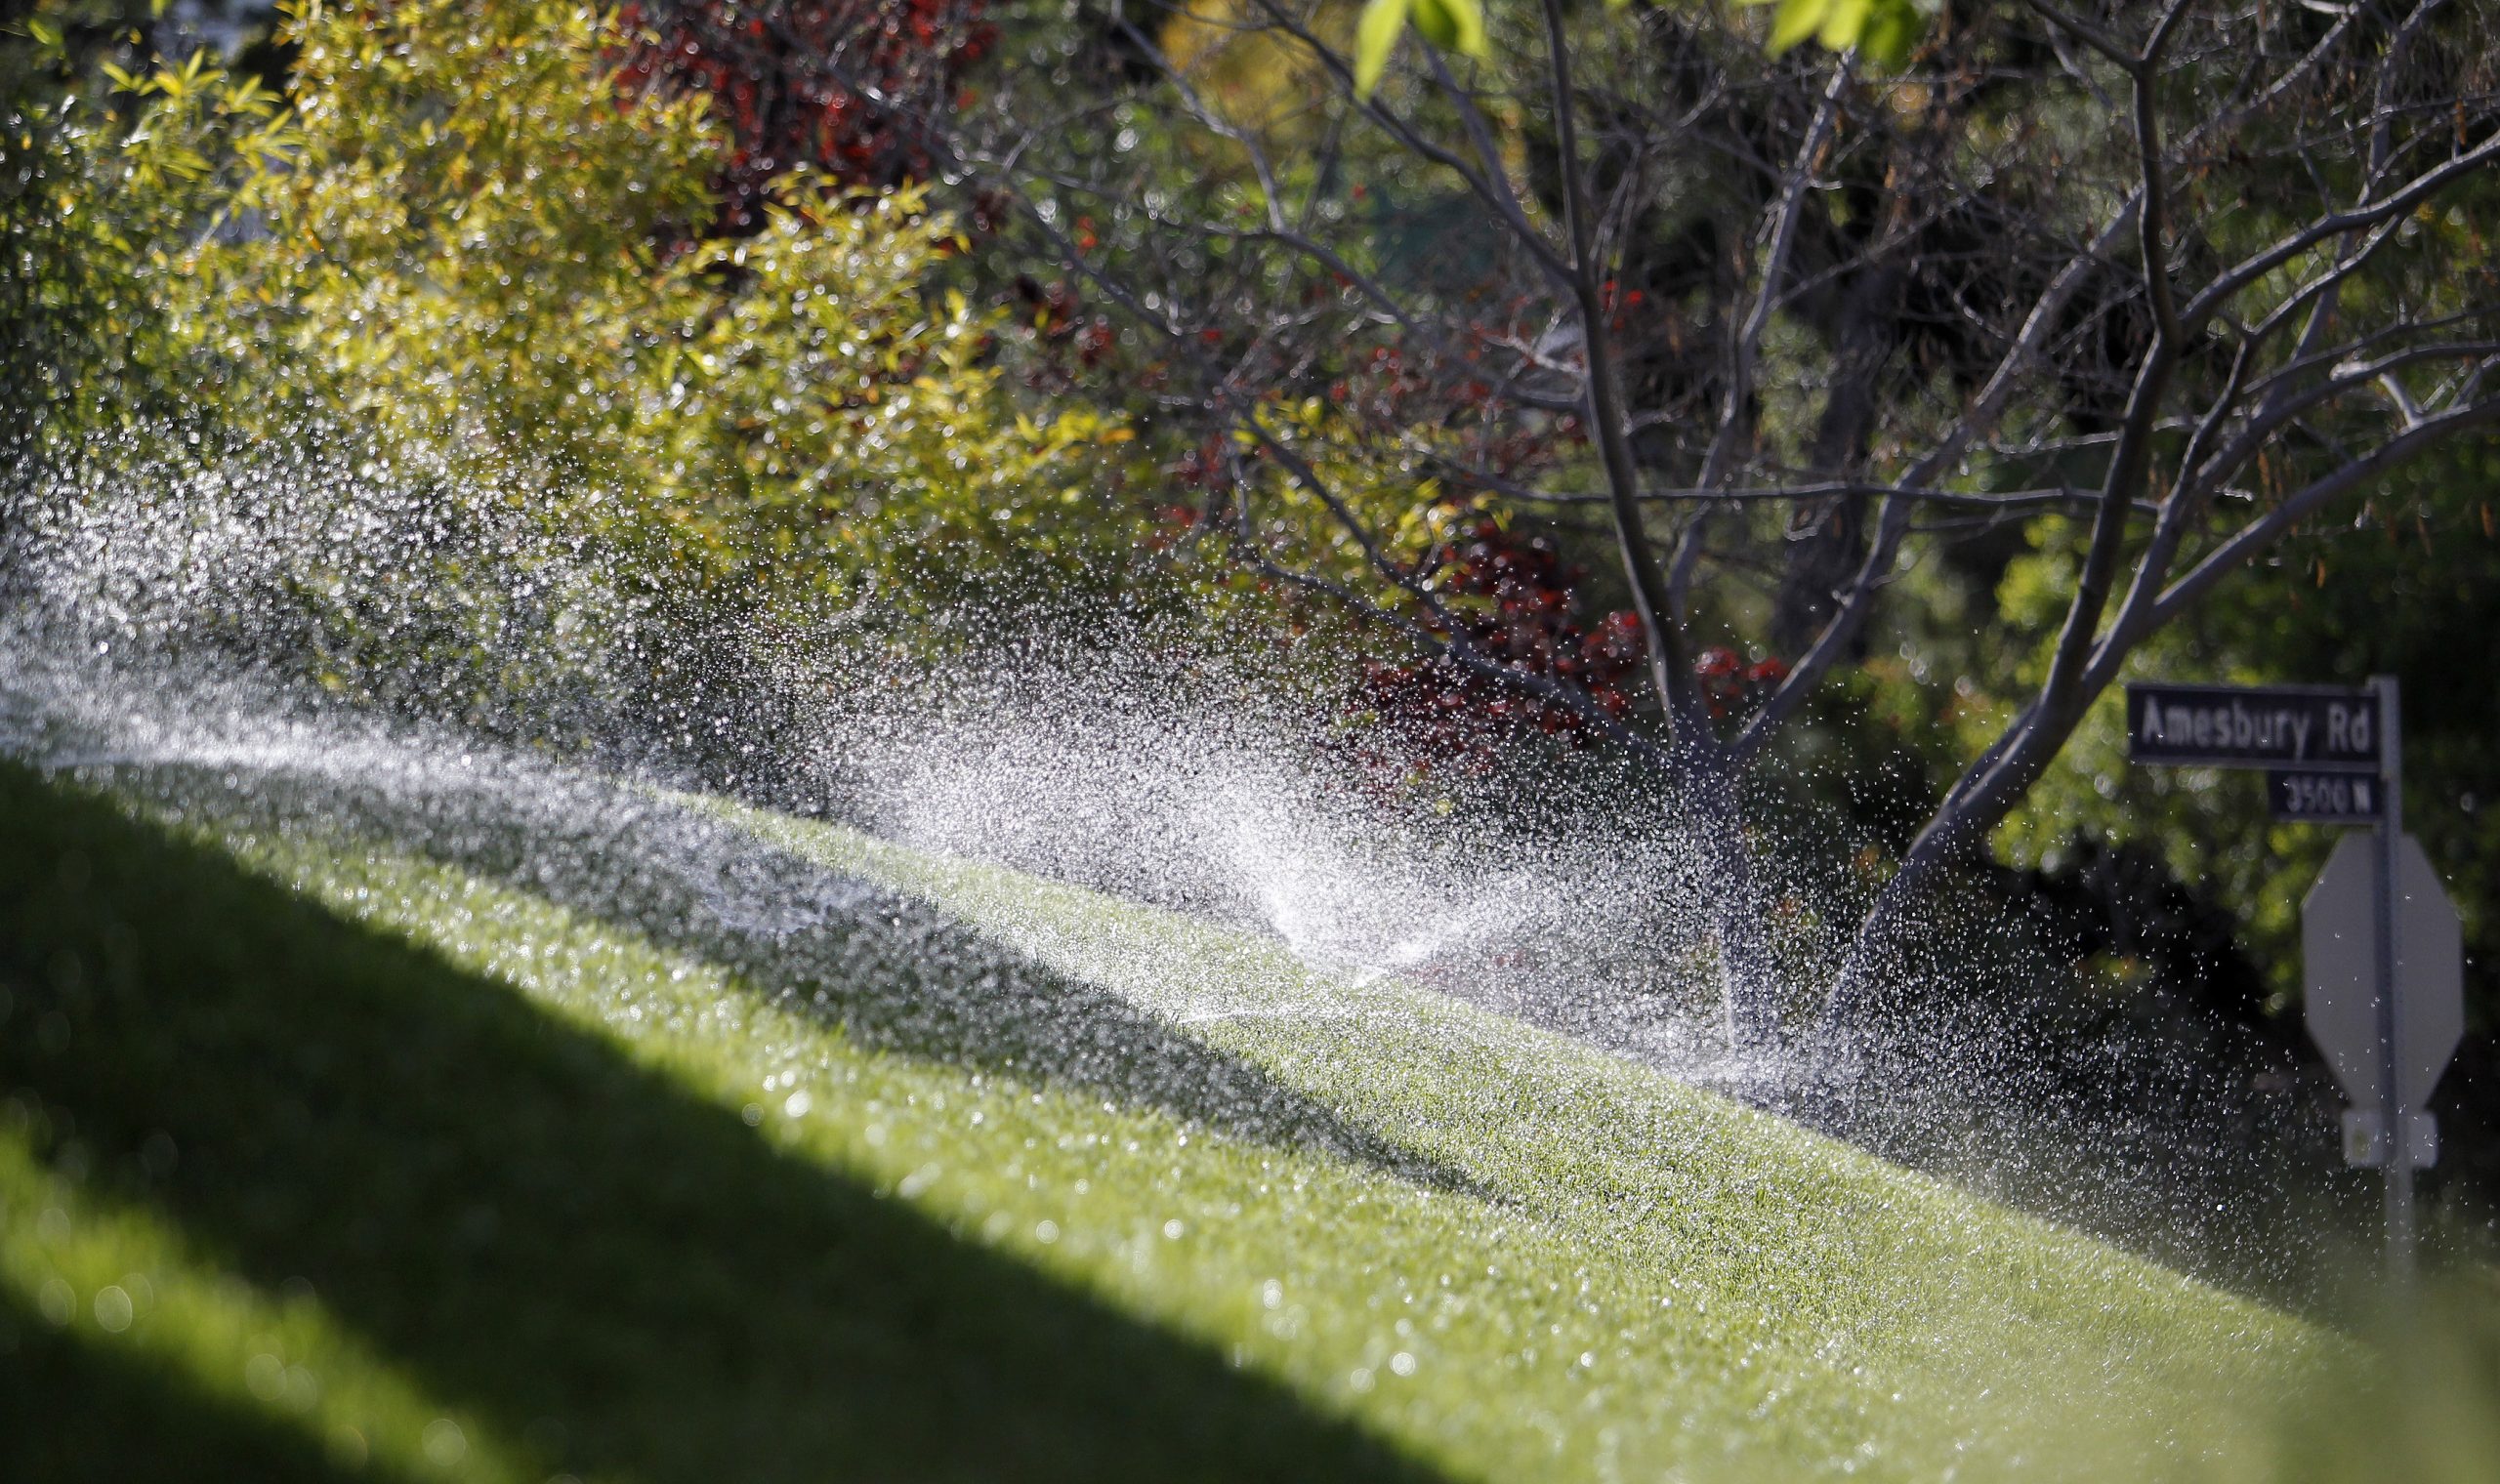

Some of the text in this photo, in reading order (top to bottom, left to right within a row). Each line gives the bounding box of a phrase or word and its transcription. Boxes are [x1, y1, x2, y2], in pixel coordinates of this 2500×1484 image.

[2142, 693, 2371, 763] Amesbury Rd
[2286, 777, 2349, 812] 3500
